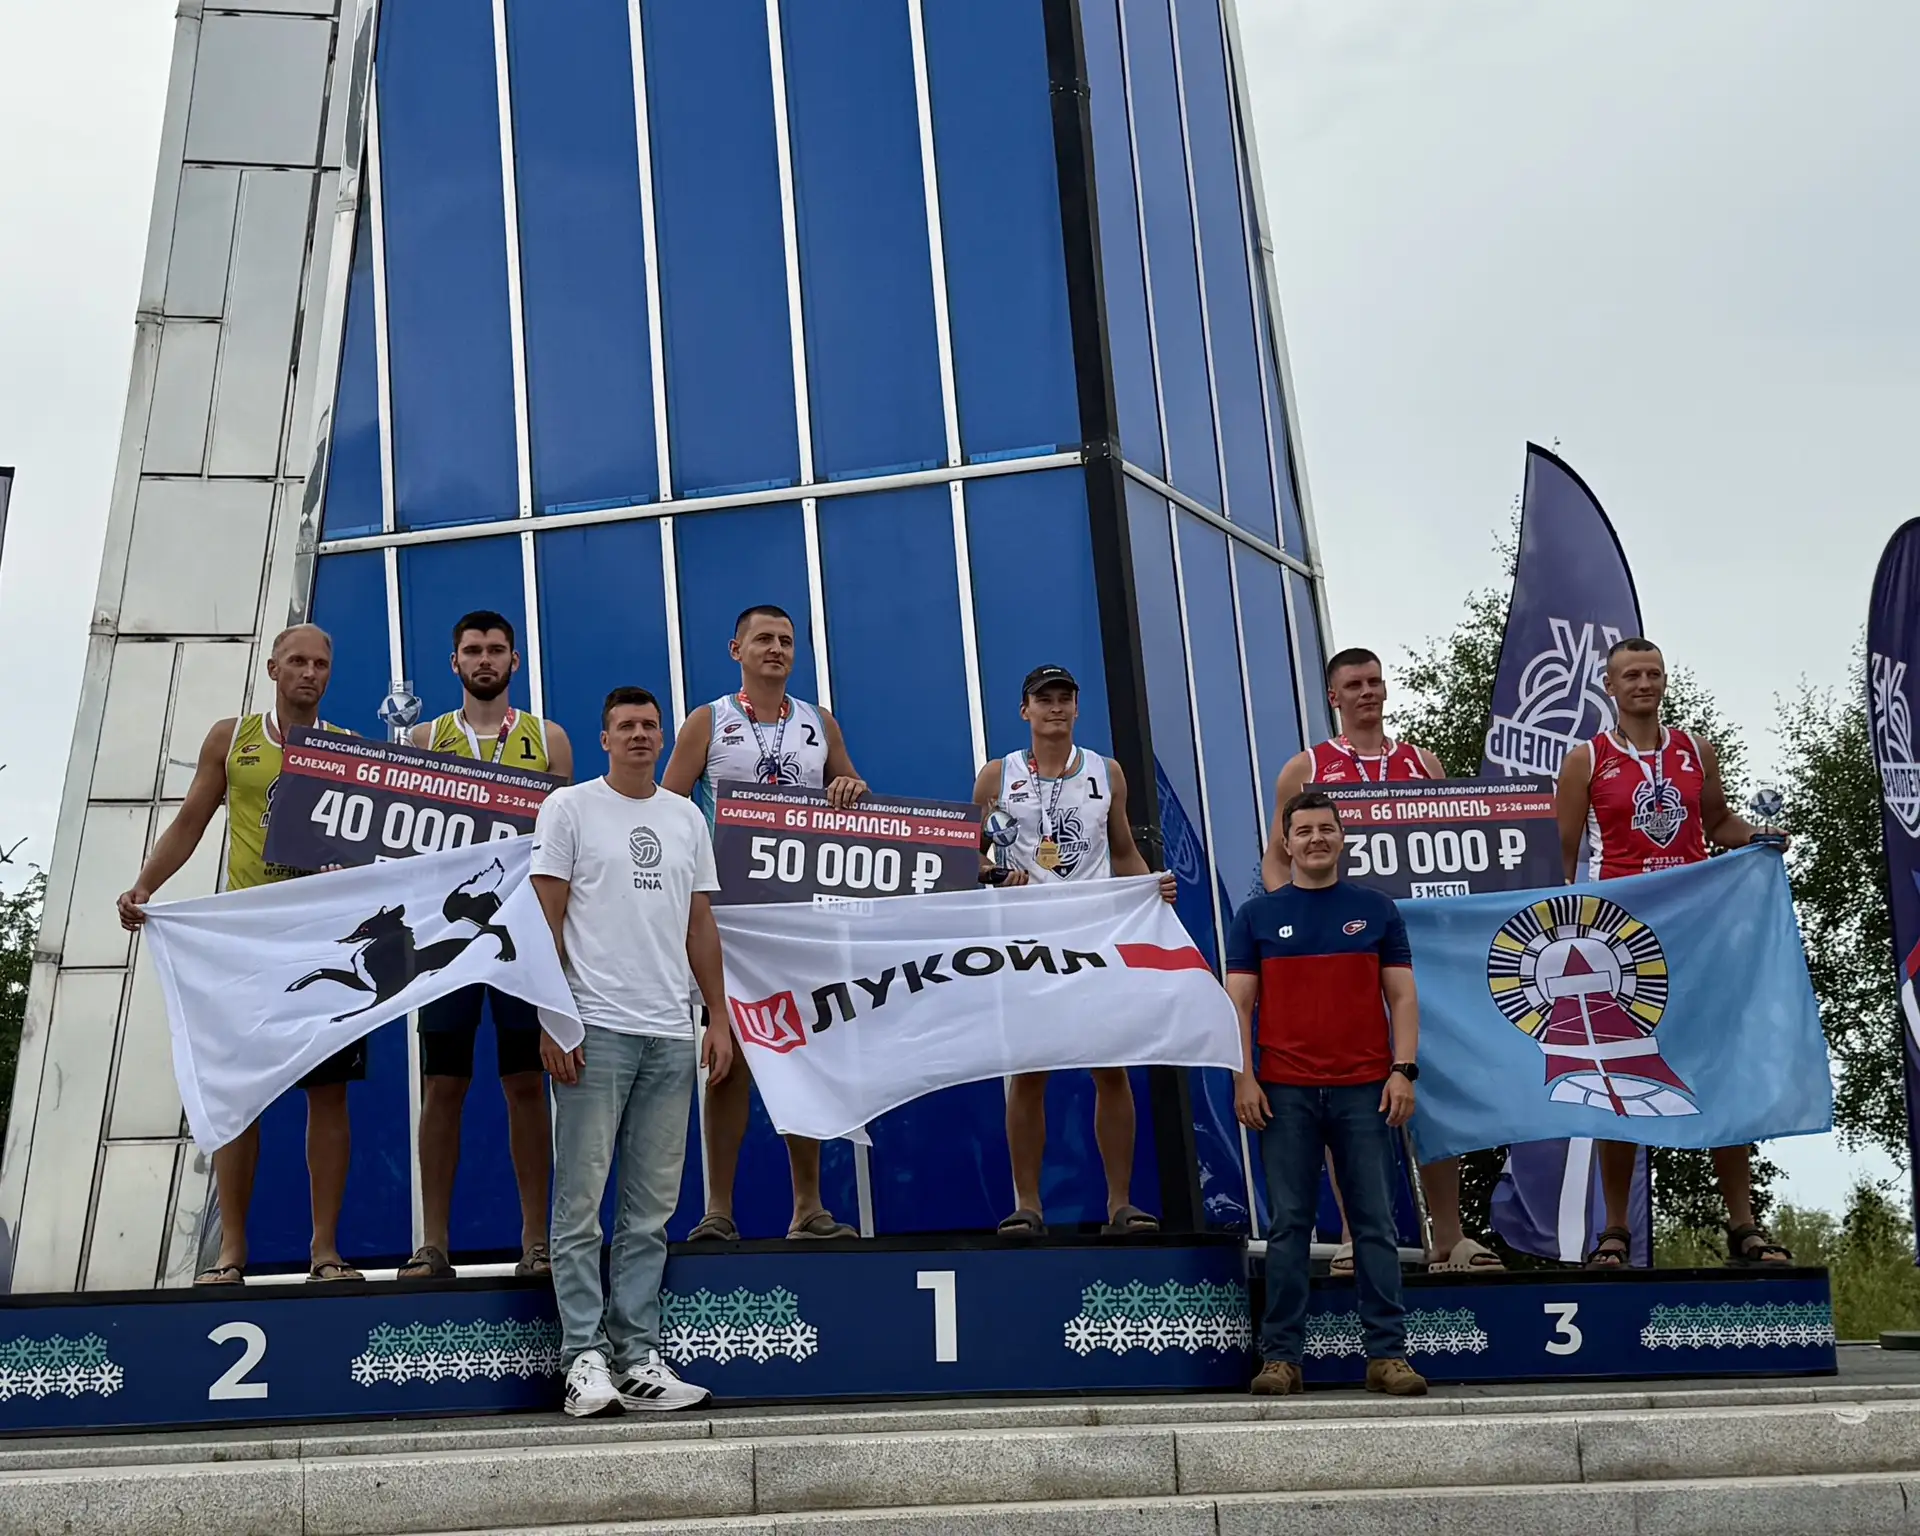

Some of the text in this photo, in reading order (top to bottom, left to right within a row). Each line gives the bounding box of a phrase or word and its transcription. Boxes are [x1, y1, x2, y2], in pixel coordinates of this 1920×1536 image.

[520, 736, 536, 760] 1
[801, 724, 819, 746] 2
[304, 737, 553, 791] ВСЕРОССИЙСКИЙ ТУРНИР ПО ПЛЯЖНОМУ ВОЛЕЙБОЛУ
[1403, 757, 1424, 779] 1
[1676, 749, 1694, 772] 2
[288, 755, 346, 776] САЛЕХАРД
[356, 763, 381, 783] 66
[384, 768, 491, 804] ПАРАЛЛЕЛЬ
[496, 793, 526, 807] 25-26
[1087, 776, 1104, 800] 1
[1323, 784, 1538, 799] ЕРОССИЙСКИЙ ТУРНИР ПО ПЛЯЖНОМУ ВОЛЕЙБОЛУ
[732, 790, 808, 805] ВСЕРОССИЙСКИЙ
[860, 802, 911, 815] ПЛЯЖНОМУ
[913, 808, 966, 820] ВОЛЕЙБОЛУ
[1370, 803, 1392, 820] 66
[1396, 800, 1491, 820] ПАРАЛЛЕЛЬ
[1495, 802, 1522, 812] 25-26
[311, 789, 373, 842] 40
[381, 802, 475, 854] 000
[721, 808, 776, 823] САЛЕХАРД
[785, 809, 808, 827] 66
[812, 811, 912, 837] ПАРАЛЛЕЛЬ
[917, 825, 946, 837] 25-26
[748, 836, 805, 883] 50
[816, 842, 901, 891] 000
[1343, 832, 1399, 877] 30
[1407, 829, 1489, 874] 000
[634, 878, 662, 891] DNA
[1415, 884, 1466, 898] 3 МЕСТО
[811, 939, 1107, 1033] ЛУКОЙЛ
[916, 1271, 958, 1362] 1
[1545, 1303, 1583, 1356] 3
[208, 1320, 269, 1401] 2
